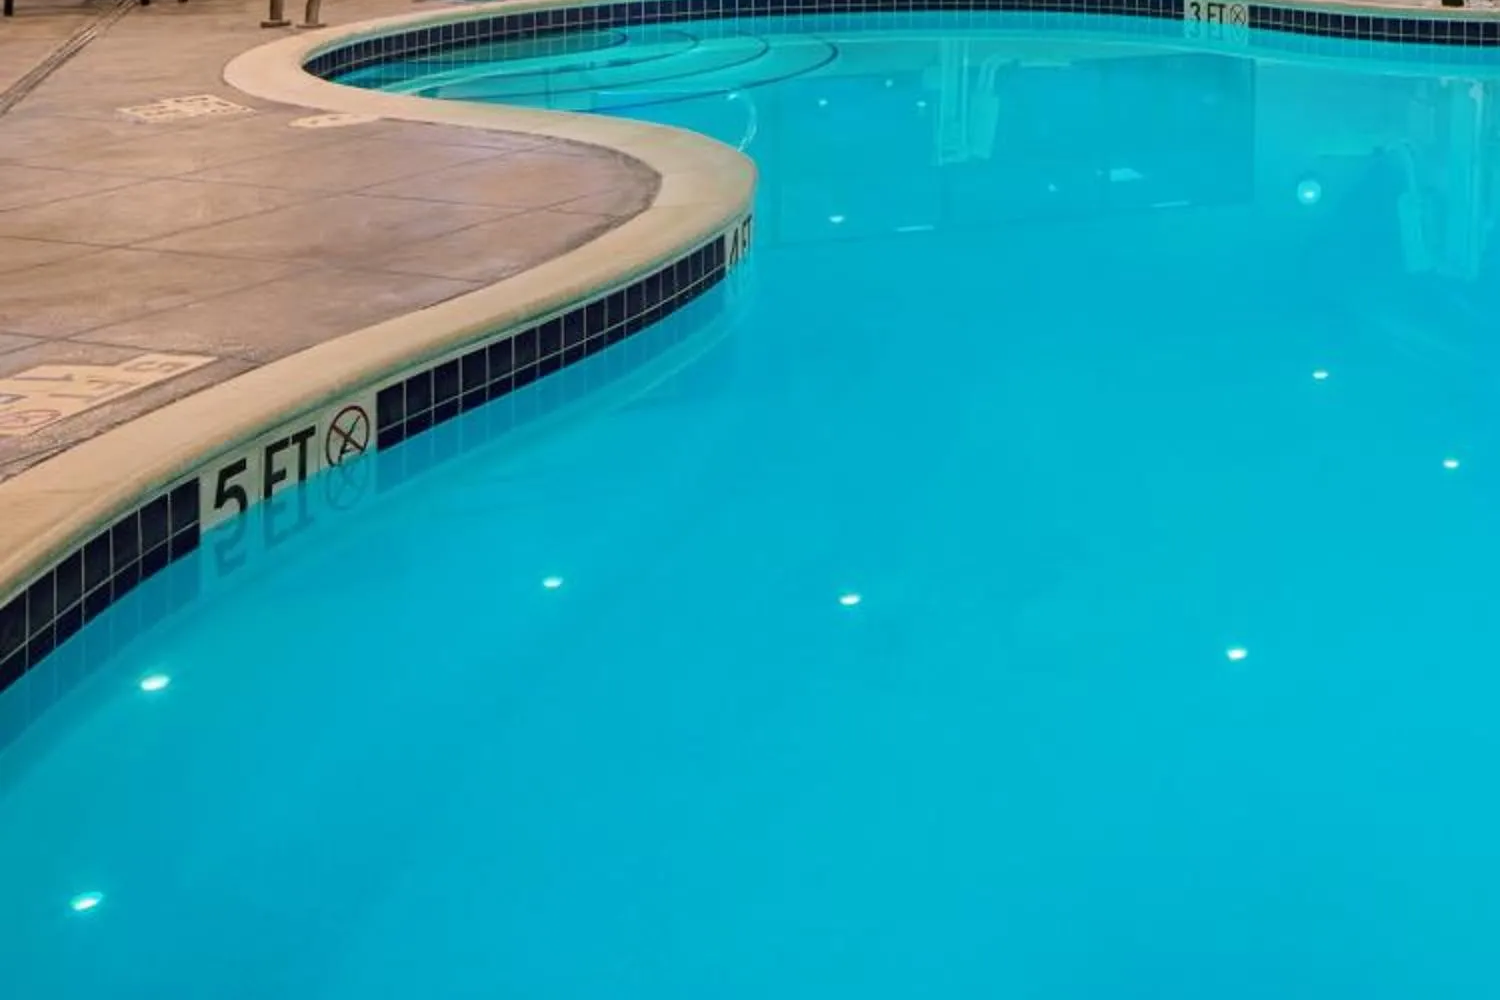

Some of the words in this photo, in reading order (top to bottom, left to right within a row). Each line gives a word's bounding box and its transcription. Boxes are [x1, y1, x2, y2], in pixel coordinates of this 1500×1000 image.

[1189, 1, 1201, 22] 3
[1207, 2, 1226, 24] FT
[213, 458, 247, 515] 5
[264, 424, 316, 499] FT
